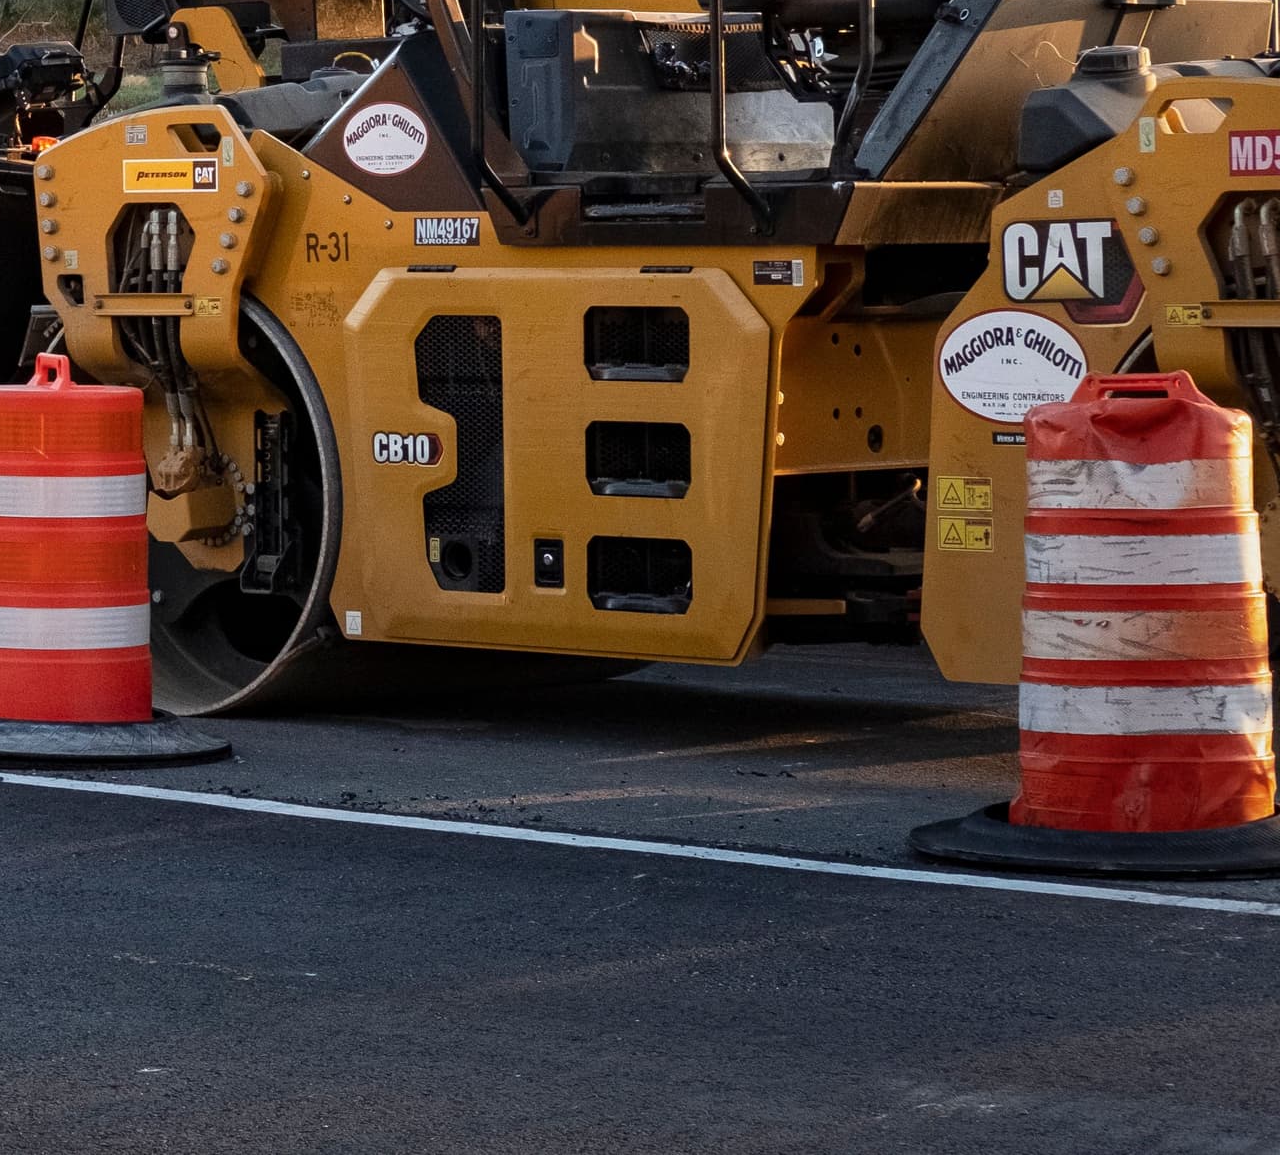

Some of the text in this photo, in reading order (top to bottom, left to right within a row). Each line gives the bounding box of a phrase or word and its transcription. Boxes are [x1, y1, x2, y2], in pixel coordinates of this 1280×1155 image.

[345, 113, 387, 147] MAGGIORA
[391, 114, 425, 145] GHILOTTI
[136, 167, 215, 183] PETERSON CAT
[416, 218, 479, 239] NM49167
[306, 232, 350, 263] R-31
[1004, 221, 1112, 300] CAT
[944, 326, 1015, 376] MAGGIORA
[1024, 329, 1083, 379] GHILOTTI
[961, 391, 1065, 402] ENGINEERING CONTRACTORS
[374, 432, 429, 464] CB10
